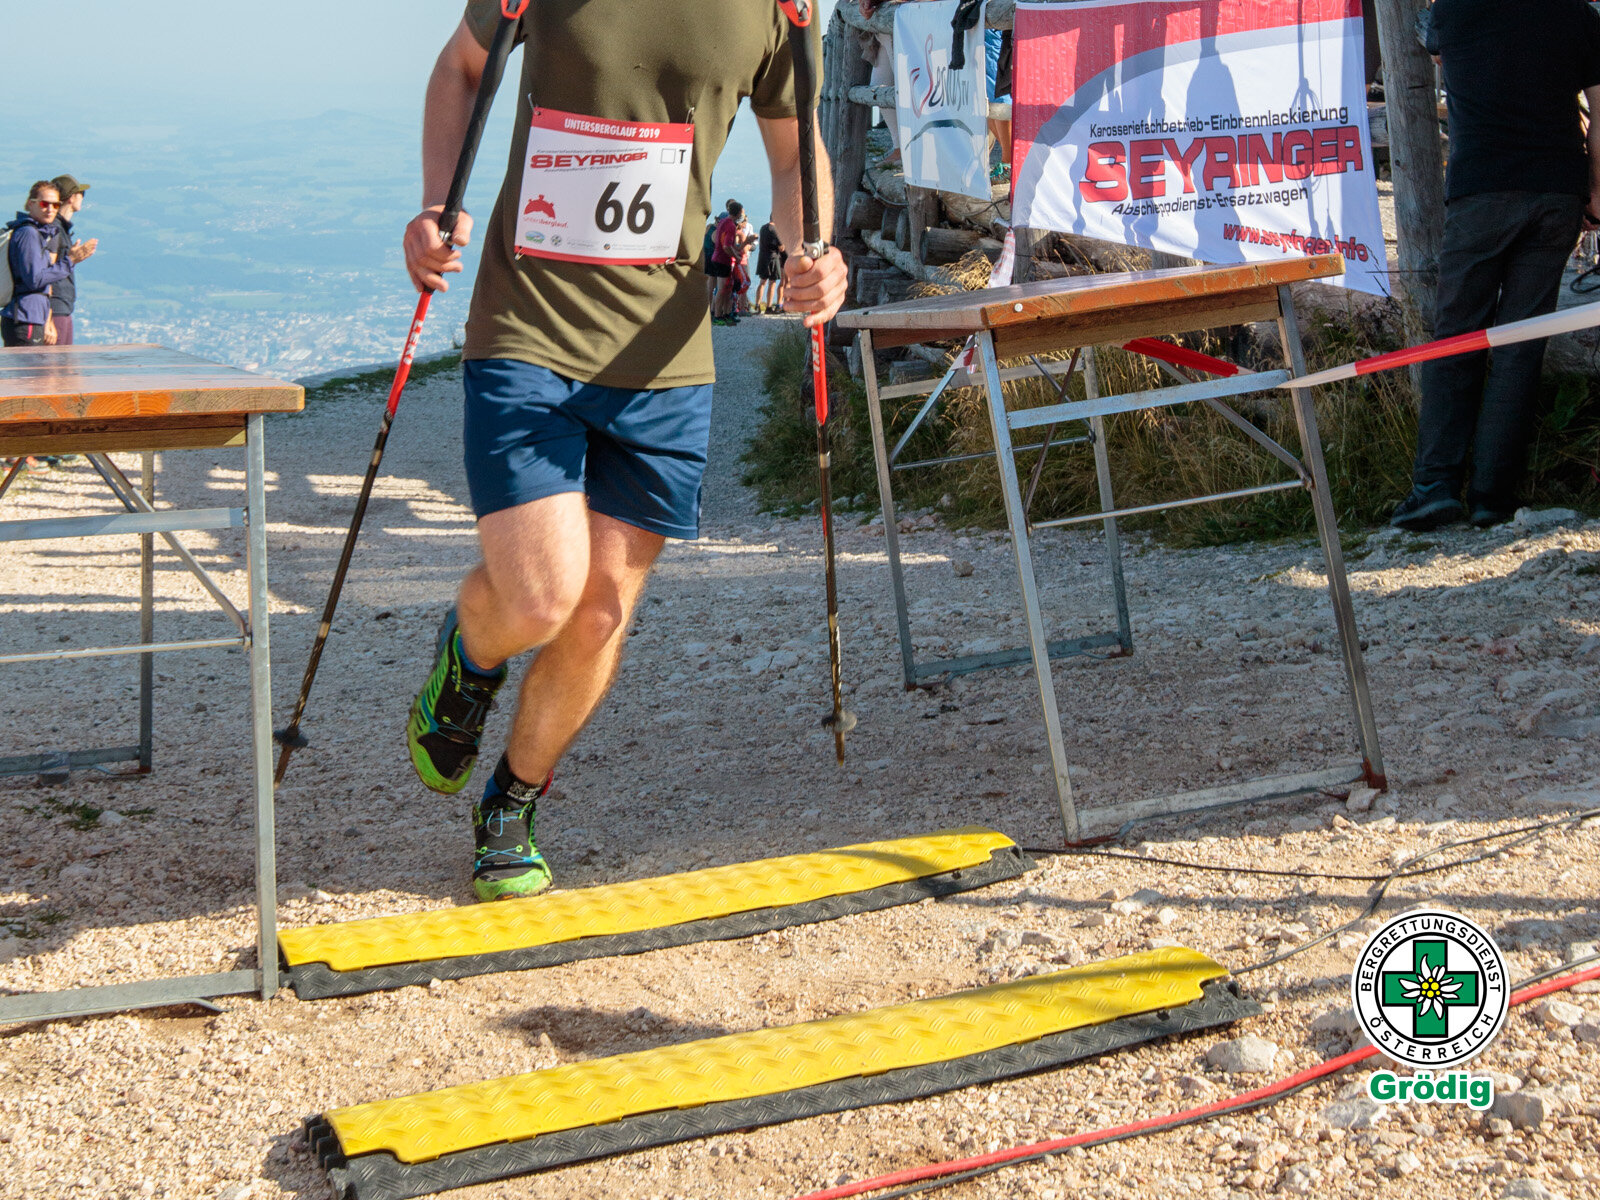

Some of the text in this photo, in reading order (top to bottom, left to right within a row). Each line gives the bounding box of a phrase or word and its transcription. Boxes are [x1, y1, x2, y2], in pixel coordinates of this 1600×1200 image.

[564, 119, 661, 139] UNTERSBERGLAUF 2019
[1089, 106, 1349, 139] Karosseriefachbetrieb-Einbrennlackierung
[530, 152, 648, 169] SEYRINGER
[678, 149, 687, 164] T
[1079, 125, 1364, 203] SEYRINGER
[595, 181, 654, 234] 66
[1111, 186, 1309, 217] Abschleppdienst-Ersatzwagen
